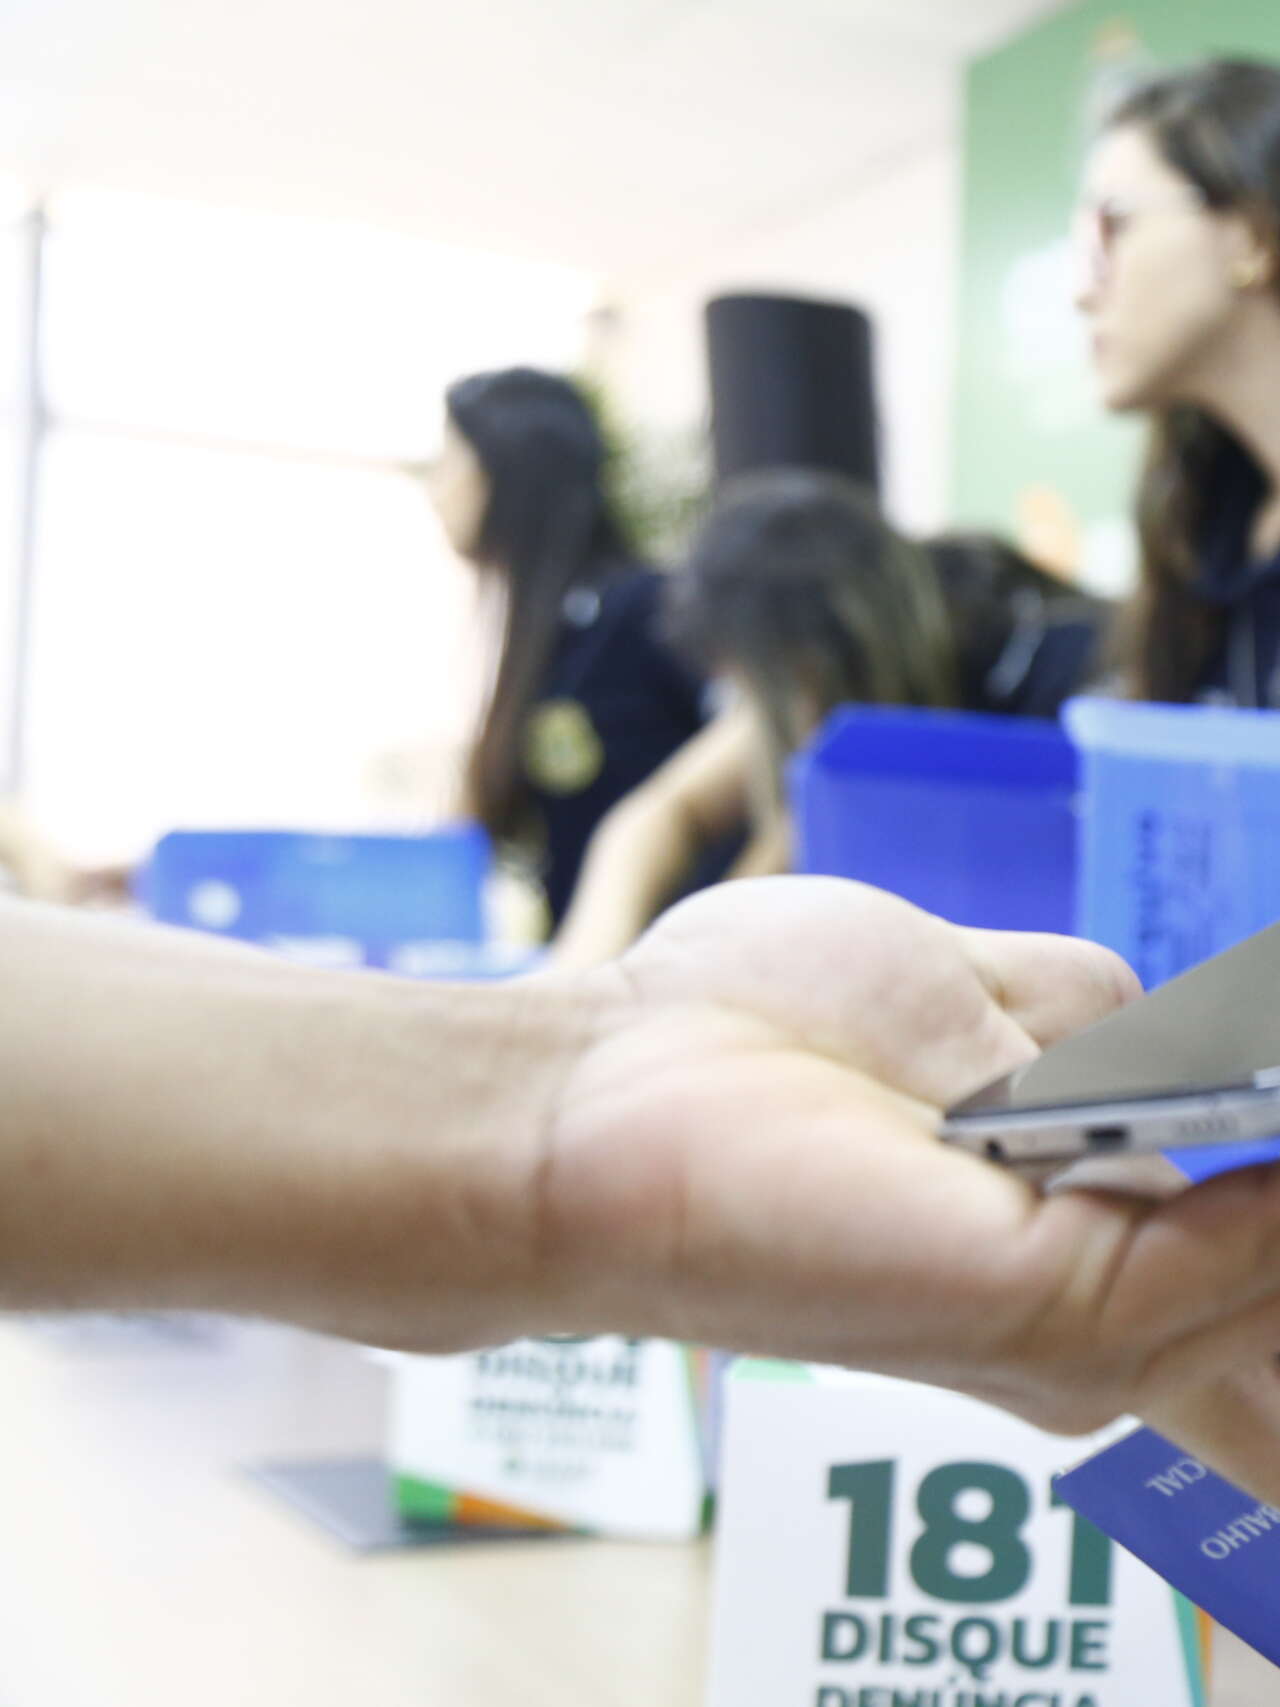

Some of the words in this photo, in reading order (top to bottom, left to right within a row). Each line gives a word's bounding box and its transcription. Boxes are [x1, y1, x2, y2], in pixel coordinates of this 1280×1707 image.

[1145, 1457, 1207, 1496] CIAL
[825, 1457, 1116, 1606] 181
[820, 1611, 1110, 1679] DISQUE
